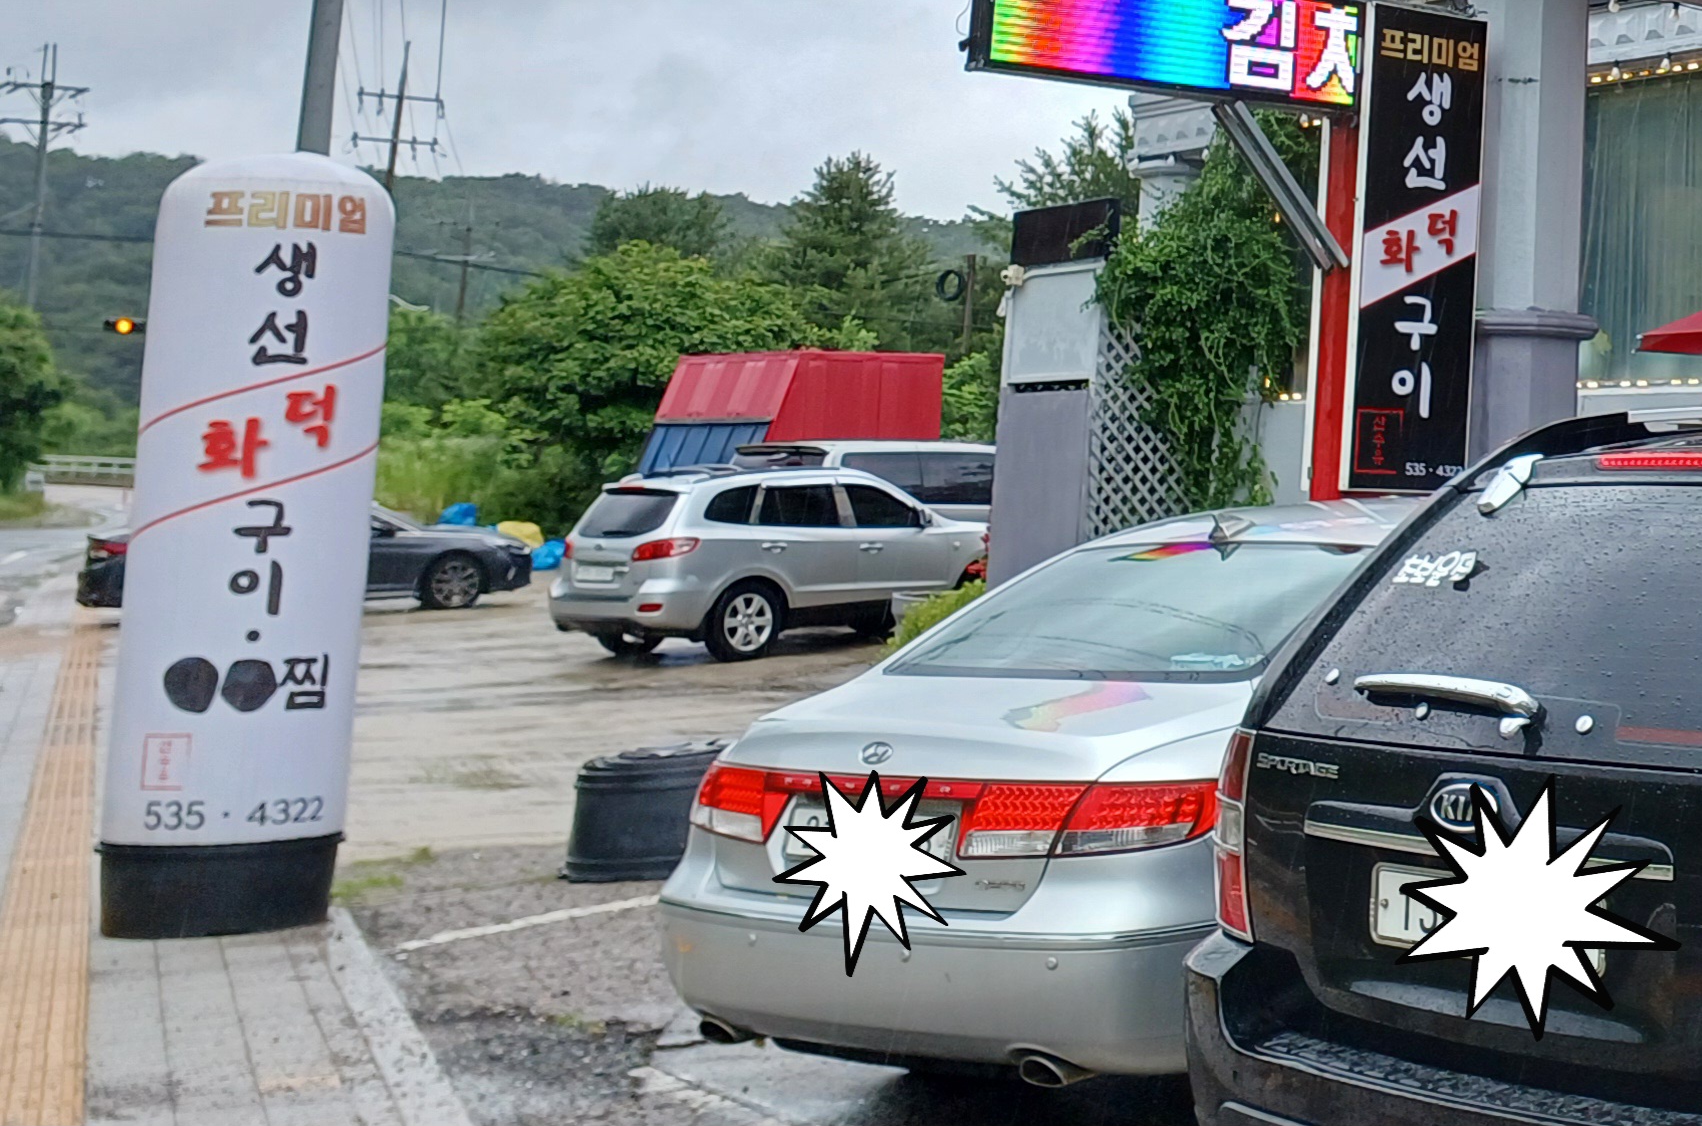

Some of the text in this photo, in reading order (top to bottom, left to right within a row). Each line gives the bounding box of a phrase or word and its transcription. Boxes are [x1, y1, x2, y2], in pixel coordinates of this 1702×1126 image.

[1380, 28, 1480, 72] 프리미엄
[1403, 71, 1452, 191] 생선
[1380, 209, 1459, 273] 화덕
[249, 241, 317, 365] 생선
[1391, 295, 1438, 419] 구이
[197, 384, 338, 479] 화덕
[1405, 462, 1427, 476] 535
[1256, 752, 1340, 779] SPORTAGE
[143, 800, 206, 831] 535
[246, 795, 324, 825] 4322
